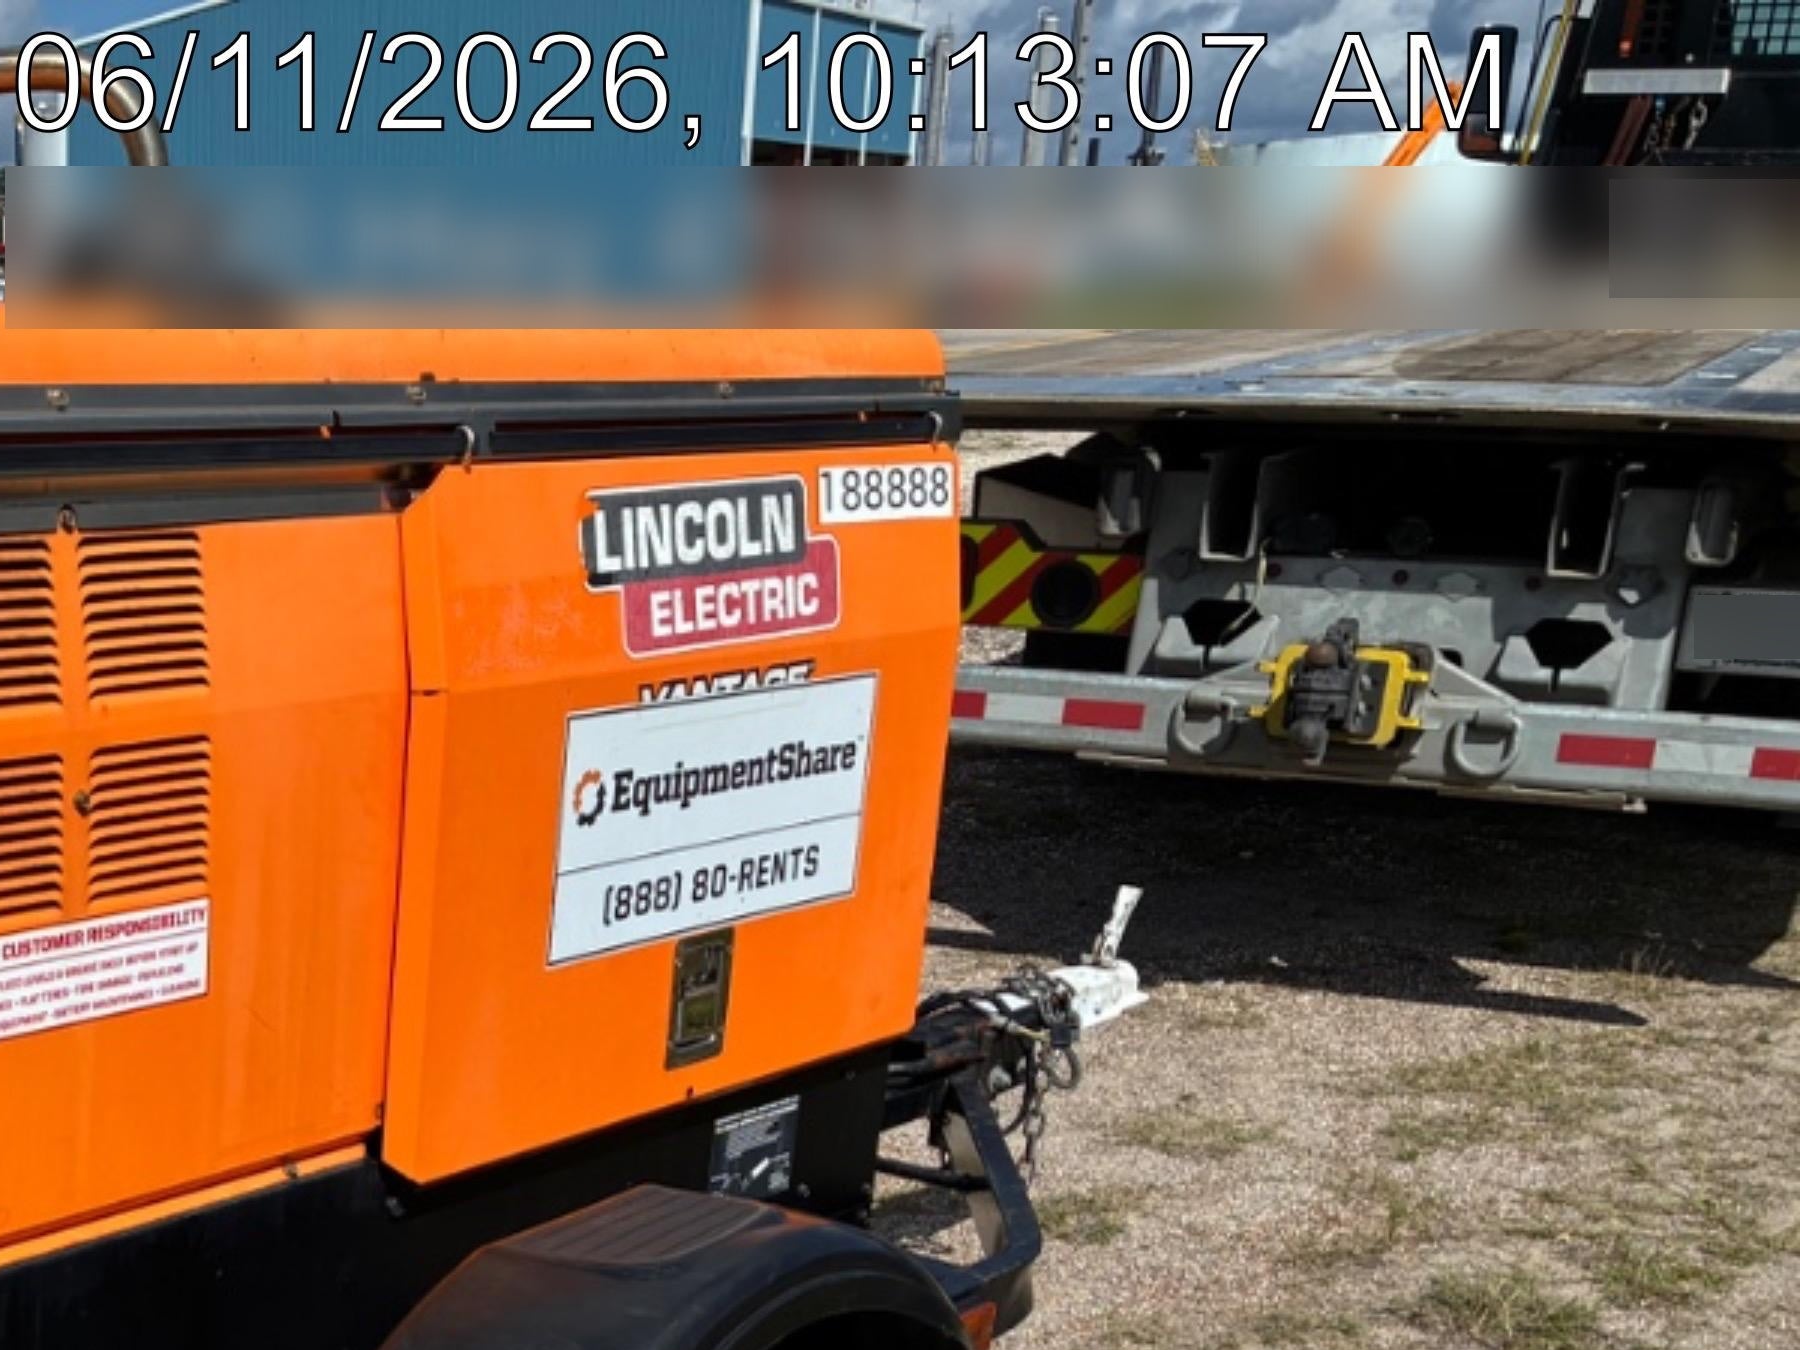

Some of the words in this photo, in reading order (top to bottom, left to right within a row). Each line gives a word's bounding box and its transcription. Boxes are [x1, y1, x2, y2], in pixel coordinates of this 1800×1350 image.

[820, 467, 950, 513] 188888
[594, 493, 796, 573] LINCOLN
[648, 572, 820, 638] ELECTRIC
[610, 741, 857, 816] EquipmentShare
[602, 870, 682, 926] (888)
[691, 845, 820, 903] 80-RENTS
[2, 927, 84, 960] CUSTOMER
[87, 908, 206, 943] RESPONSIBILITY
